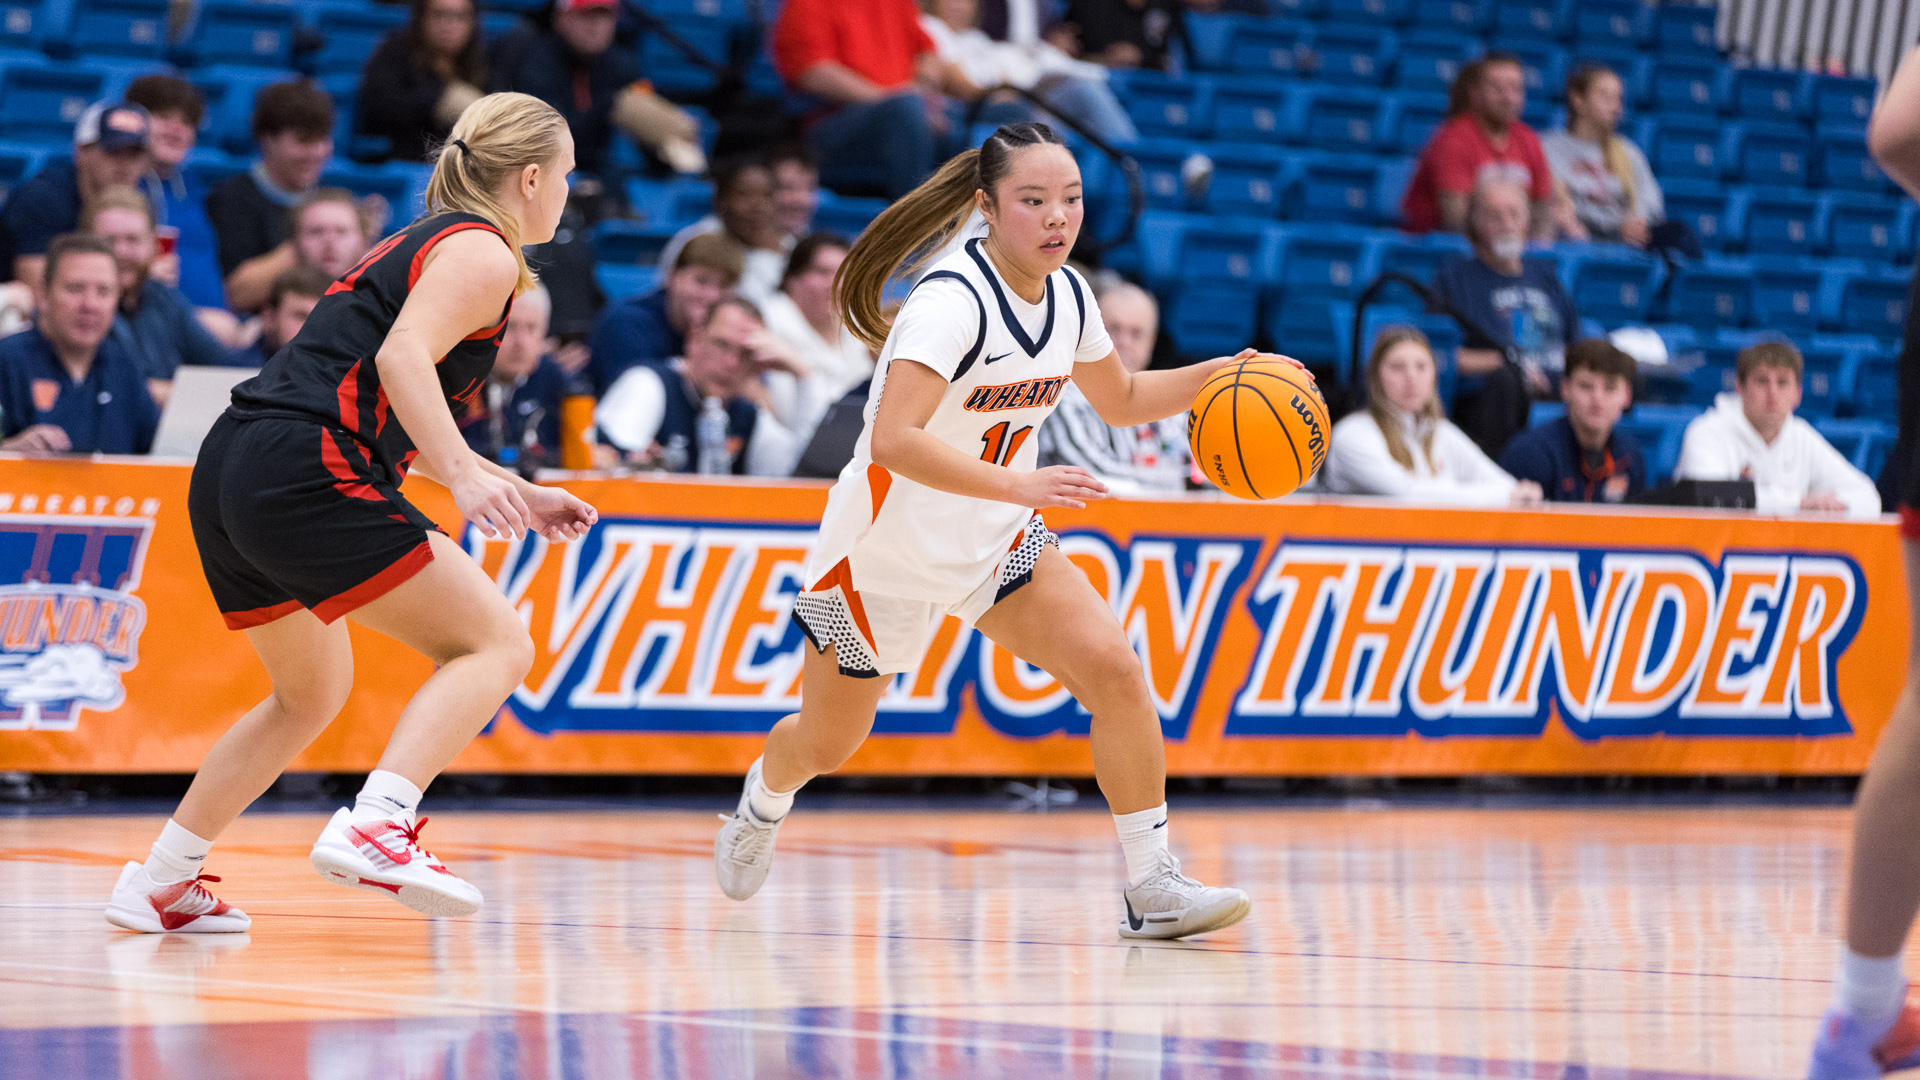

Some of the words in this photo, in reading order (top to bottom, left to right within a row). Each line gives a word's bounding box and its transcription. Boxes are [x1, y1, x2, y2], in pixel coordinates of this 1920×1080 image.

[963, 375, 1071, 413] WHEATO
[1290, 393, 1325, 479] Wilson
[0, 594, 138, 654] UNDER
[467, 522, 1244, 722] WHEON
[1234, 543, 1857, 722] THUNDER
